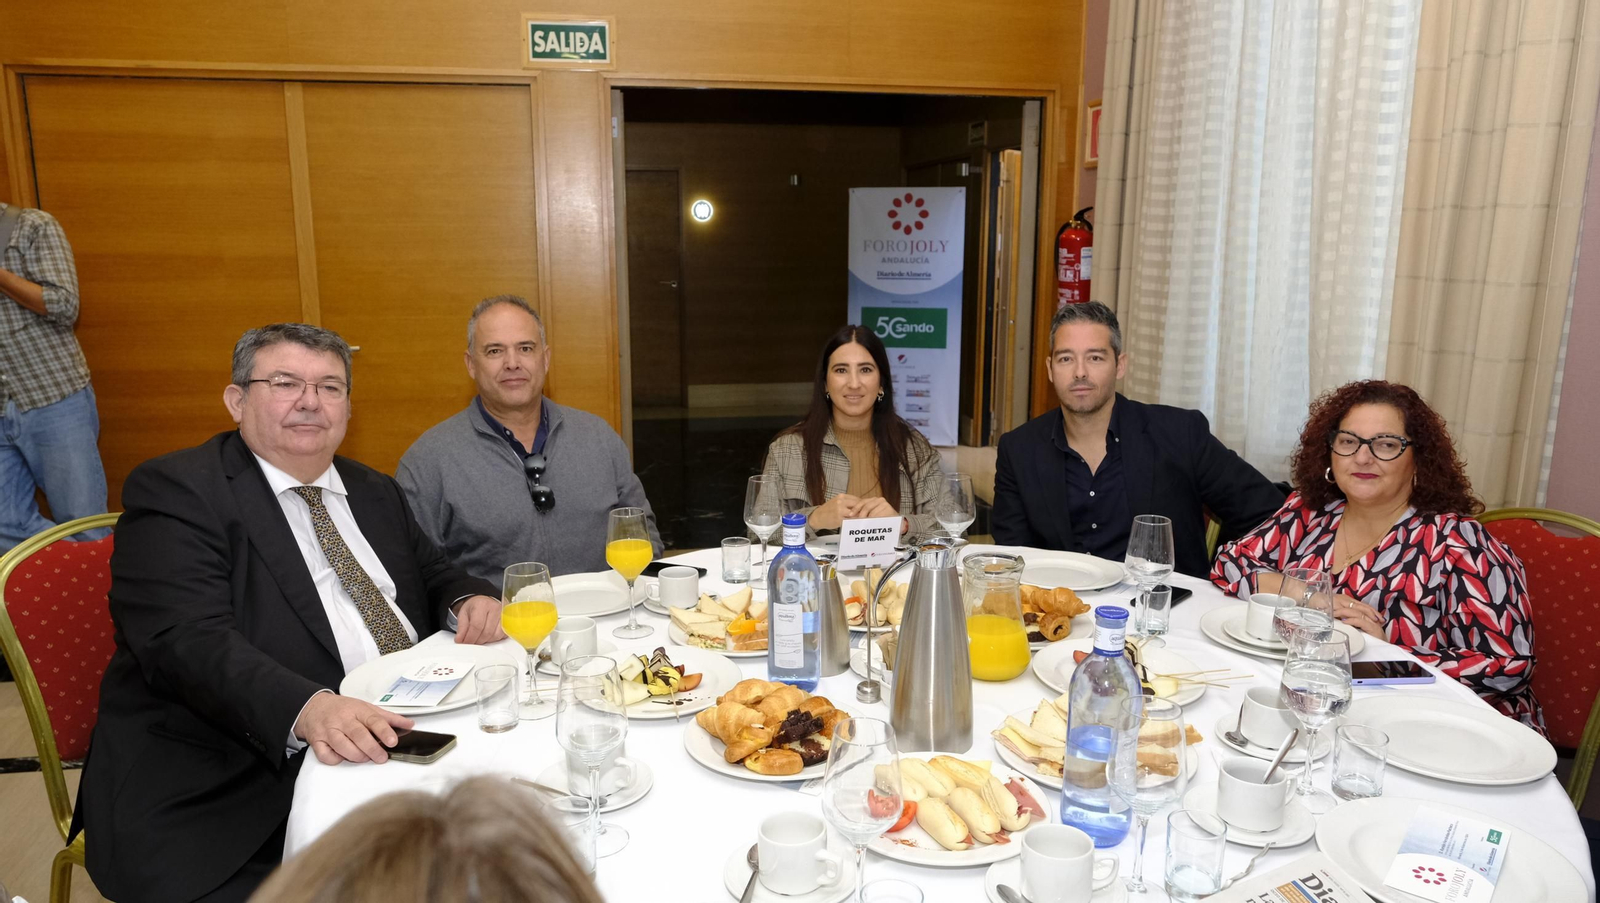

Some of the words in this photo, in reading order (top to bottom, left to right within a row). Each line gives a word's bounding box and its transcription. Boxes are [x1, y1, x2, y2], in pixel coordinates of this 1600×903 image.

[533, 30, 605, 54] SALIDA
[881, 256, 930, 264] ANDALUCÍA
[895, 323, 935, 333] sando
